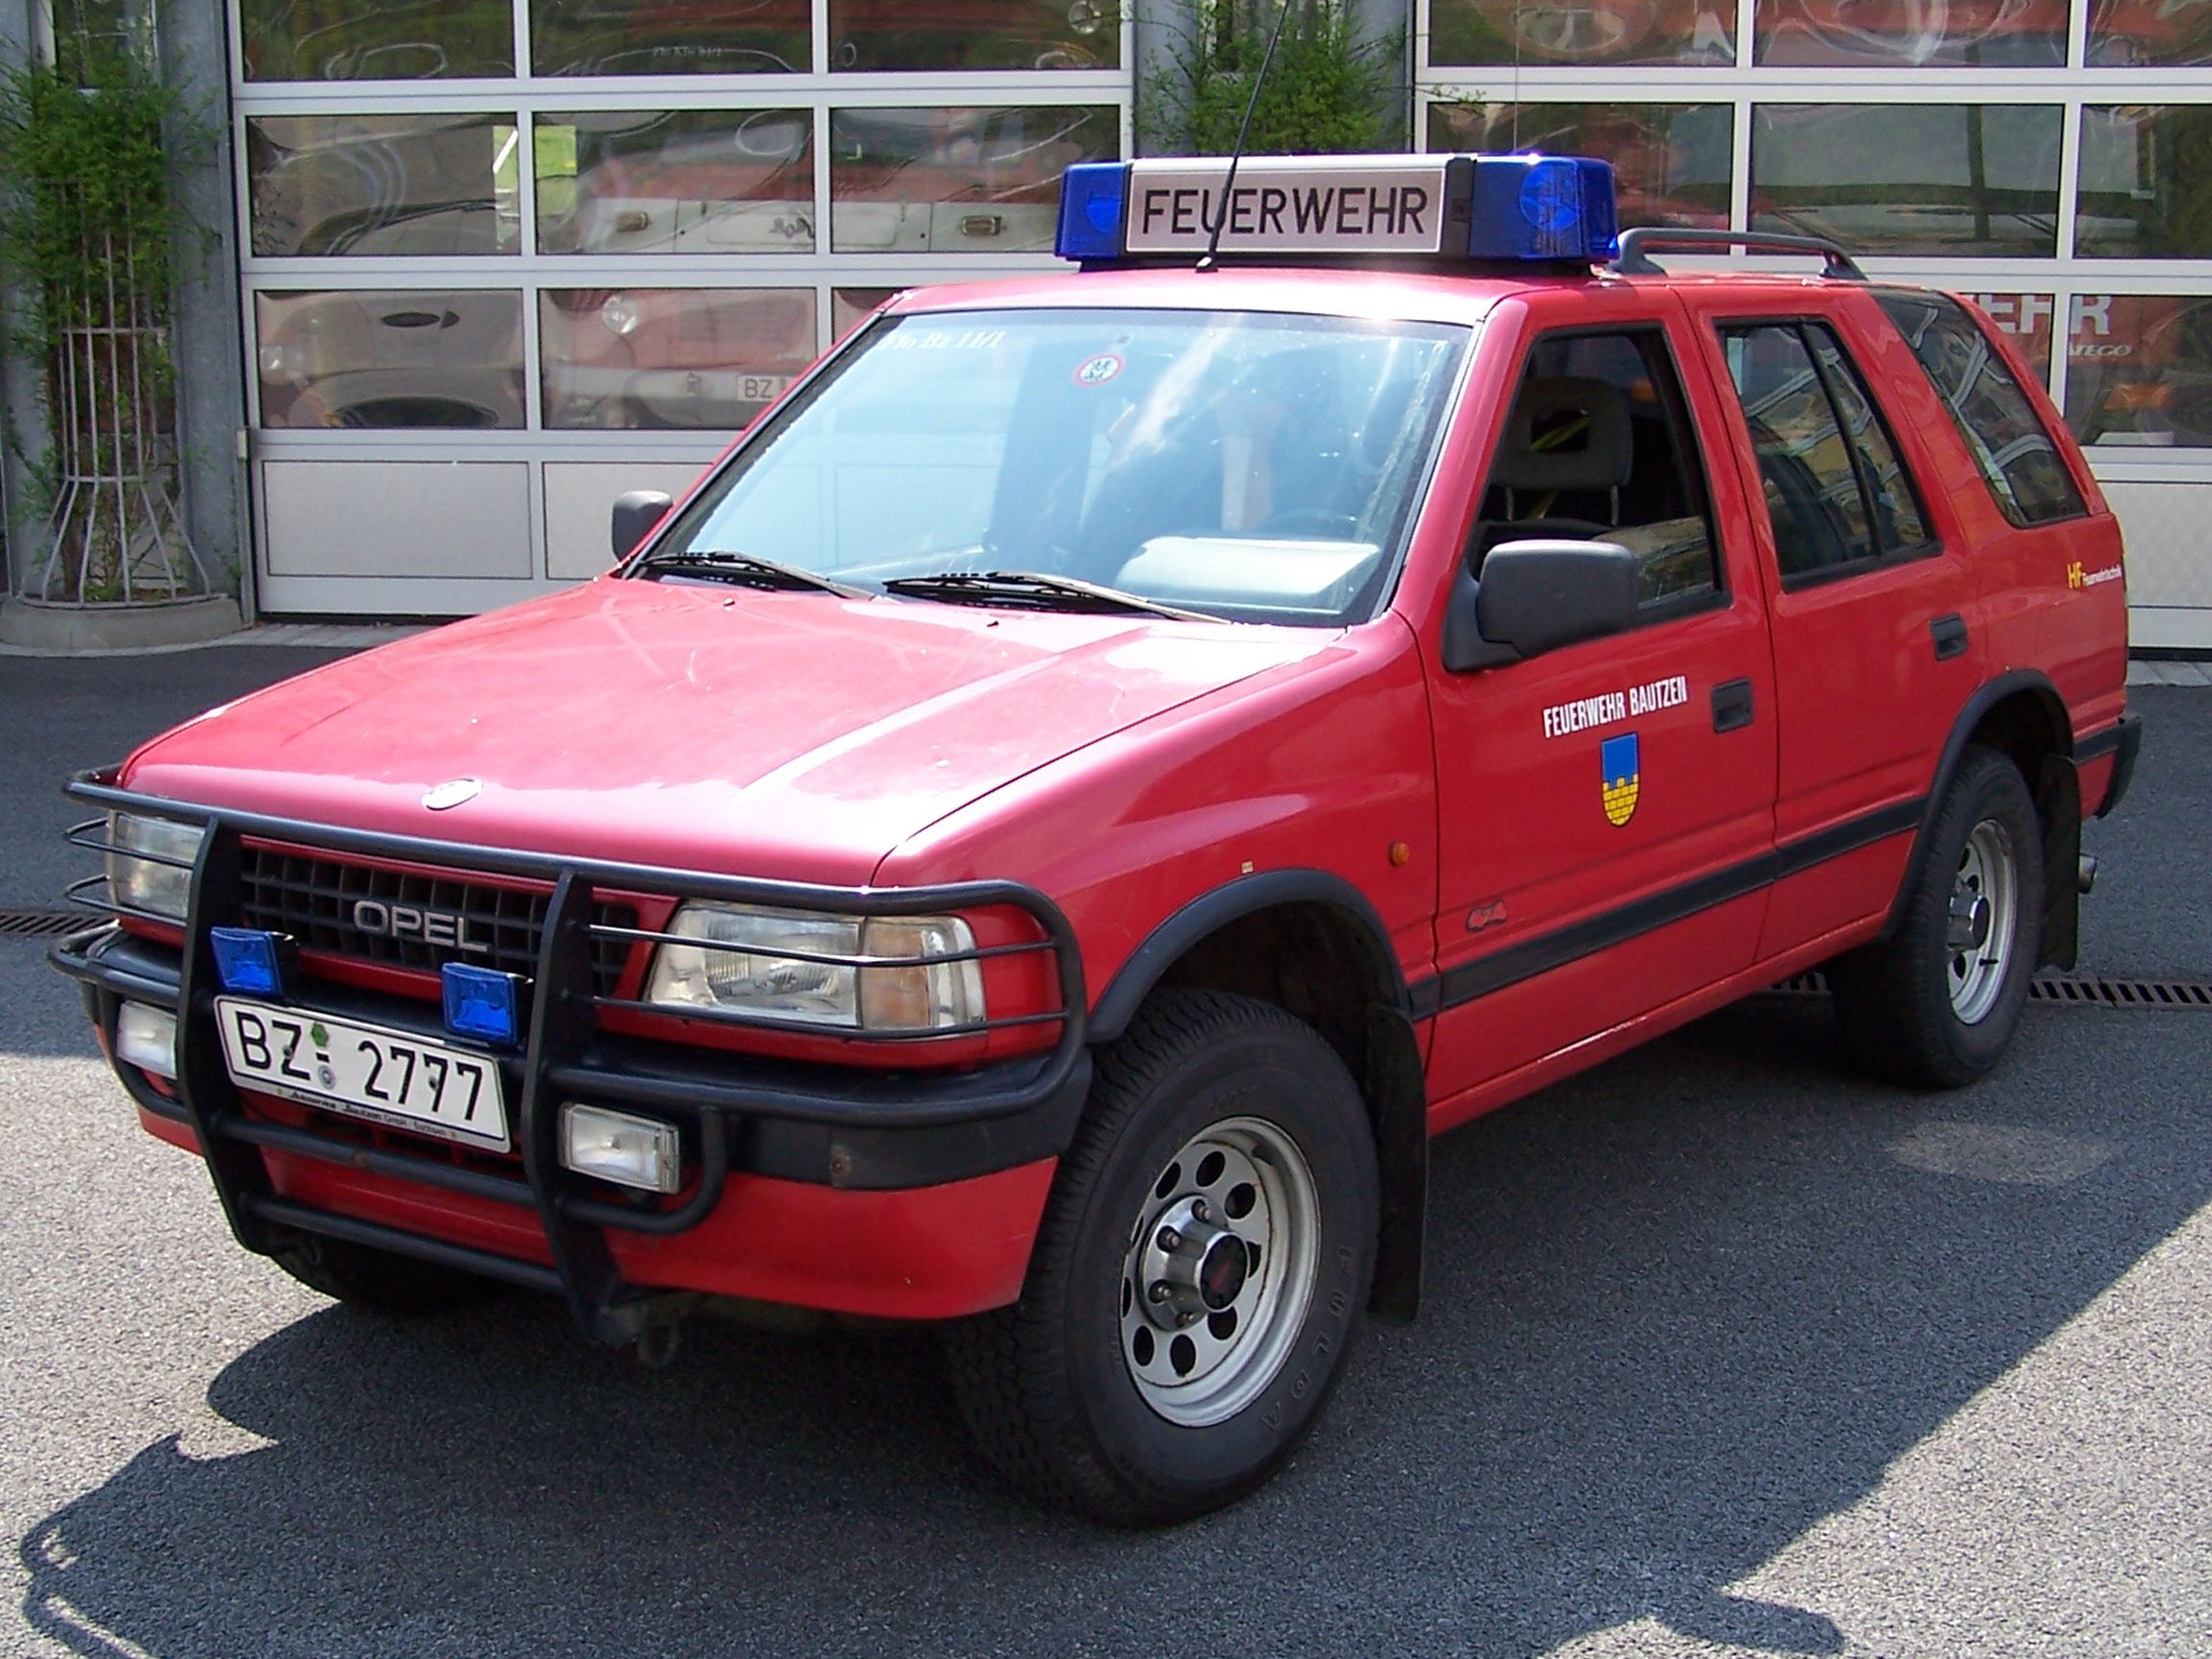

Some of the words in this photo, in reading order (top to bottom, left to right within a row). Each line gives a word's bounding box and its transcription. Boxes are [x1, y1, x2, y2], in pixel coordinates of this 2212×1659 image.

[1142, 186, 1428, 234] FEUERWEHR
[1543, 692, 1625, 738] FEUERWEHR
[1629, 676, 1688, 716] BAUTZEN
[353, 900, 488, 952] OPEL
[358, 1040, 482, 1120] 2777
